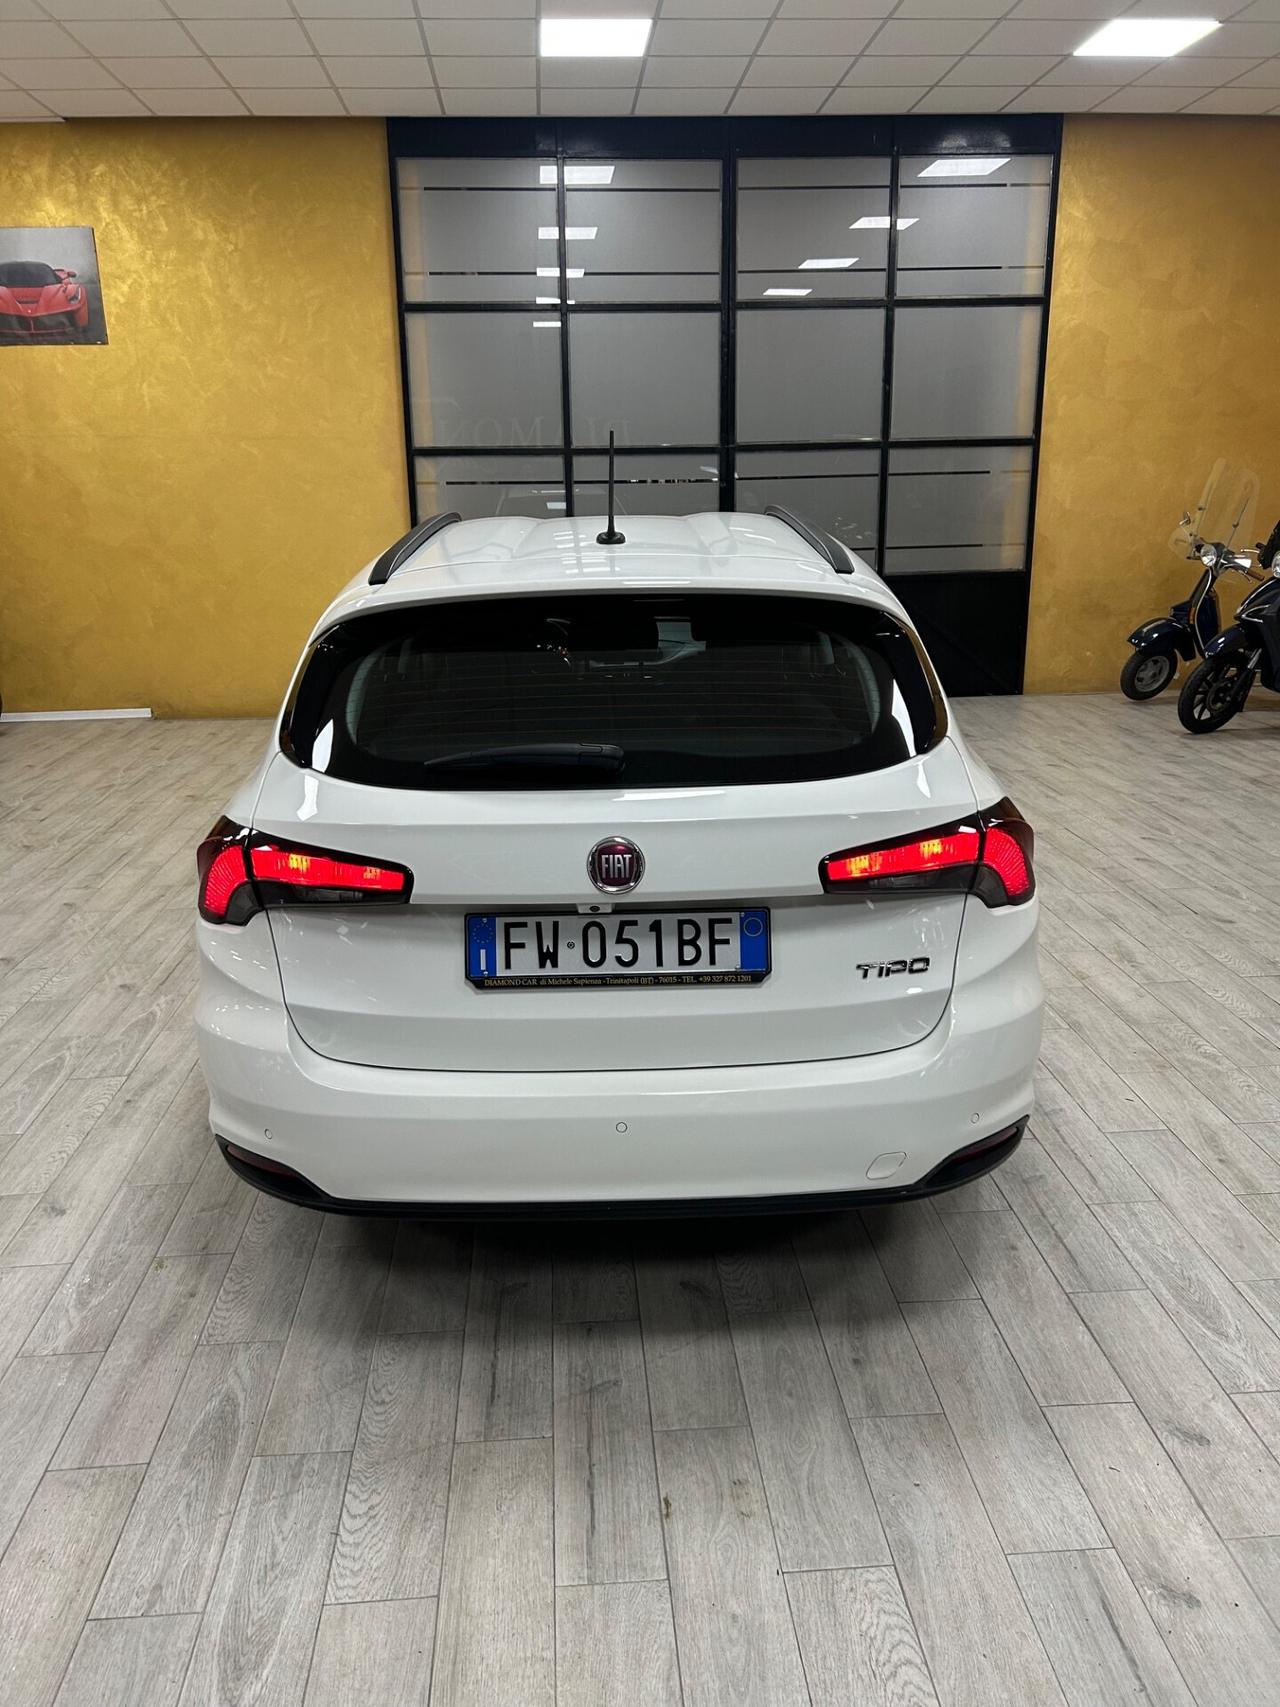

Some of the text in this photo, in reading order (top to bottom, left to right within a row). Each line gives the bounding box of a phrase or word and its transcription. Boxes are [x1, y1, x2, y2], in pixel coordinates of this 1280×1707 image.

[601, 854, 632, 879] FIAT
[504, 918, 732, 970] FW 051BF
[856, 957, 930, 979] TIPO
[606, 977, 639, 986] Trinitapoli
[699, 975, 711, 983] +39
